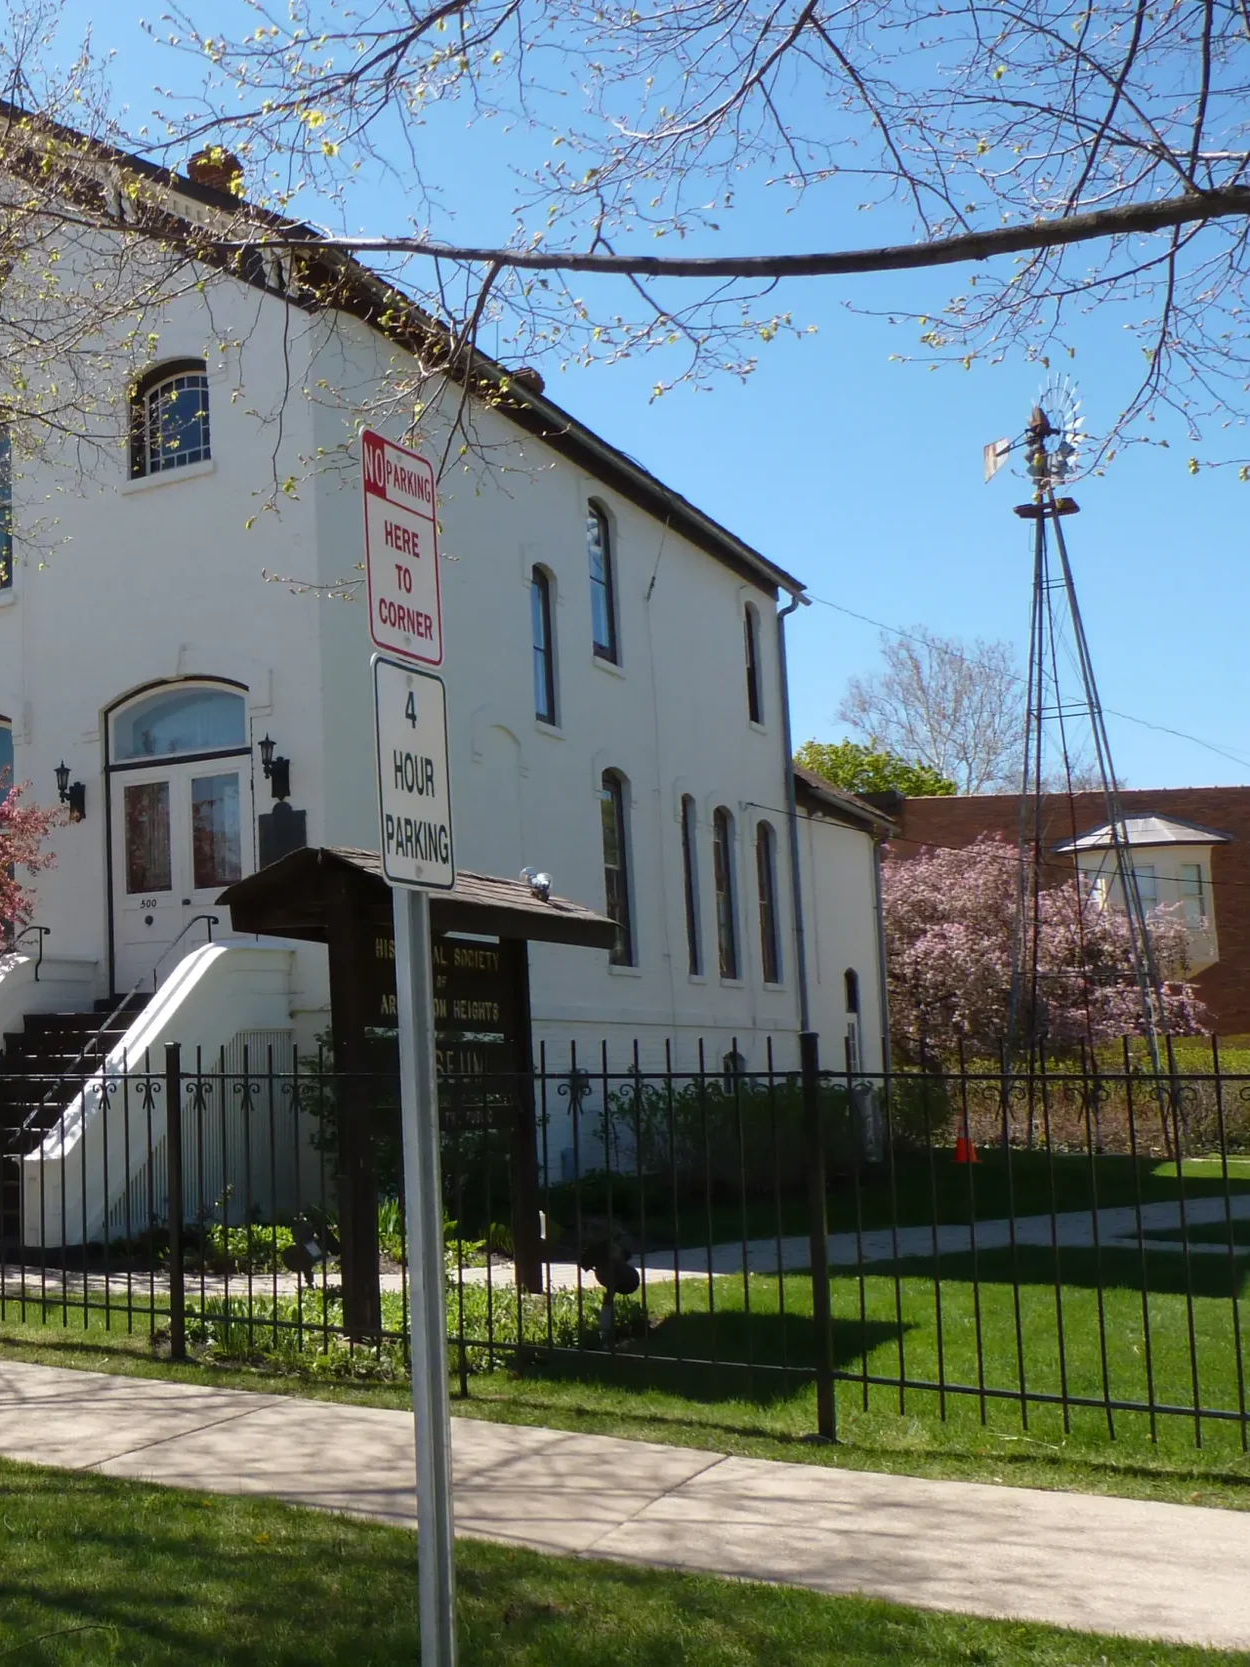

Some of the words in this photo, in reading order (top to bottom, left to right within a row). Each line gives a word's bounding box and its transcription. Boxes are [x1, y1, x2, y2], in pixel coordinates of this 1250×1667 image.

[363, 441, 385, 488] NO
[386, 460, 431, 504] PARKING
[384, 519, 420, 559] HERE
[395, 563, 412, 594] TO
[379, 597, 434, 641] CORNER
[405, 691, 417, 729] 4
[393, 749, 435, 798] HOUR
[385, 813, 450, 865] PARKING
[140, 898, 157, 909] 500
[454, 947, 500, 971] SOCIETY
[453, 999, 500, 1022] HEIGHTS
